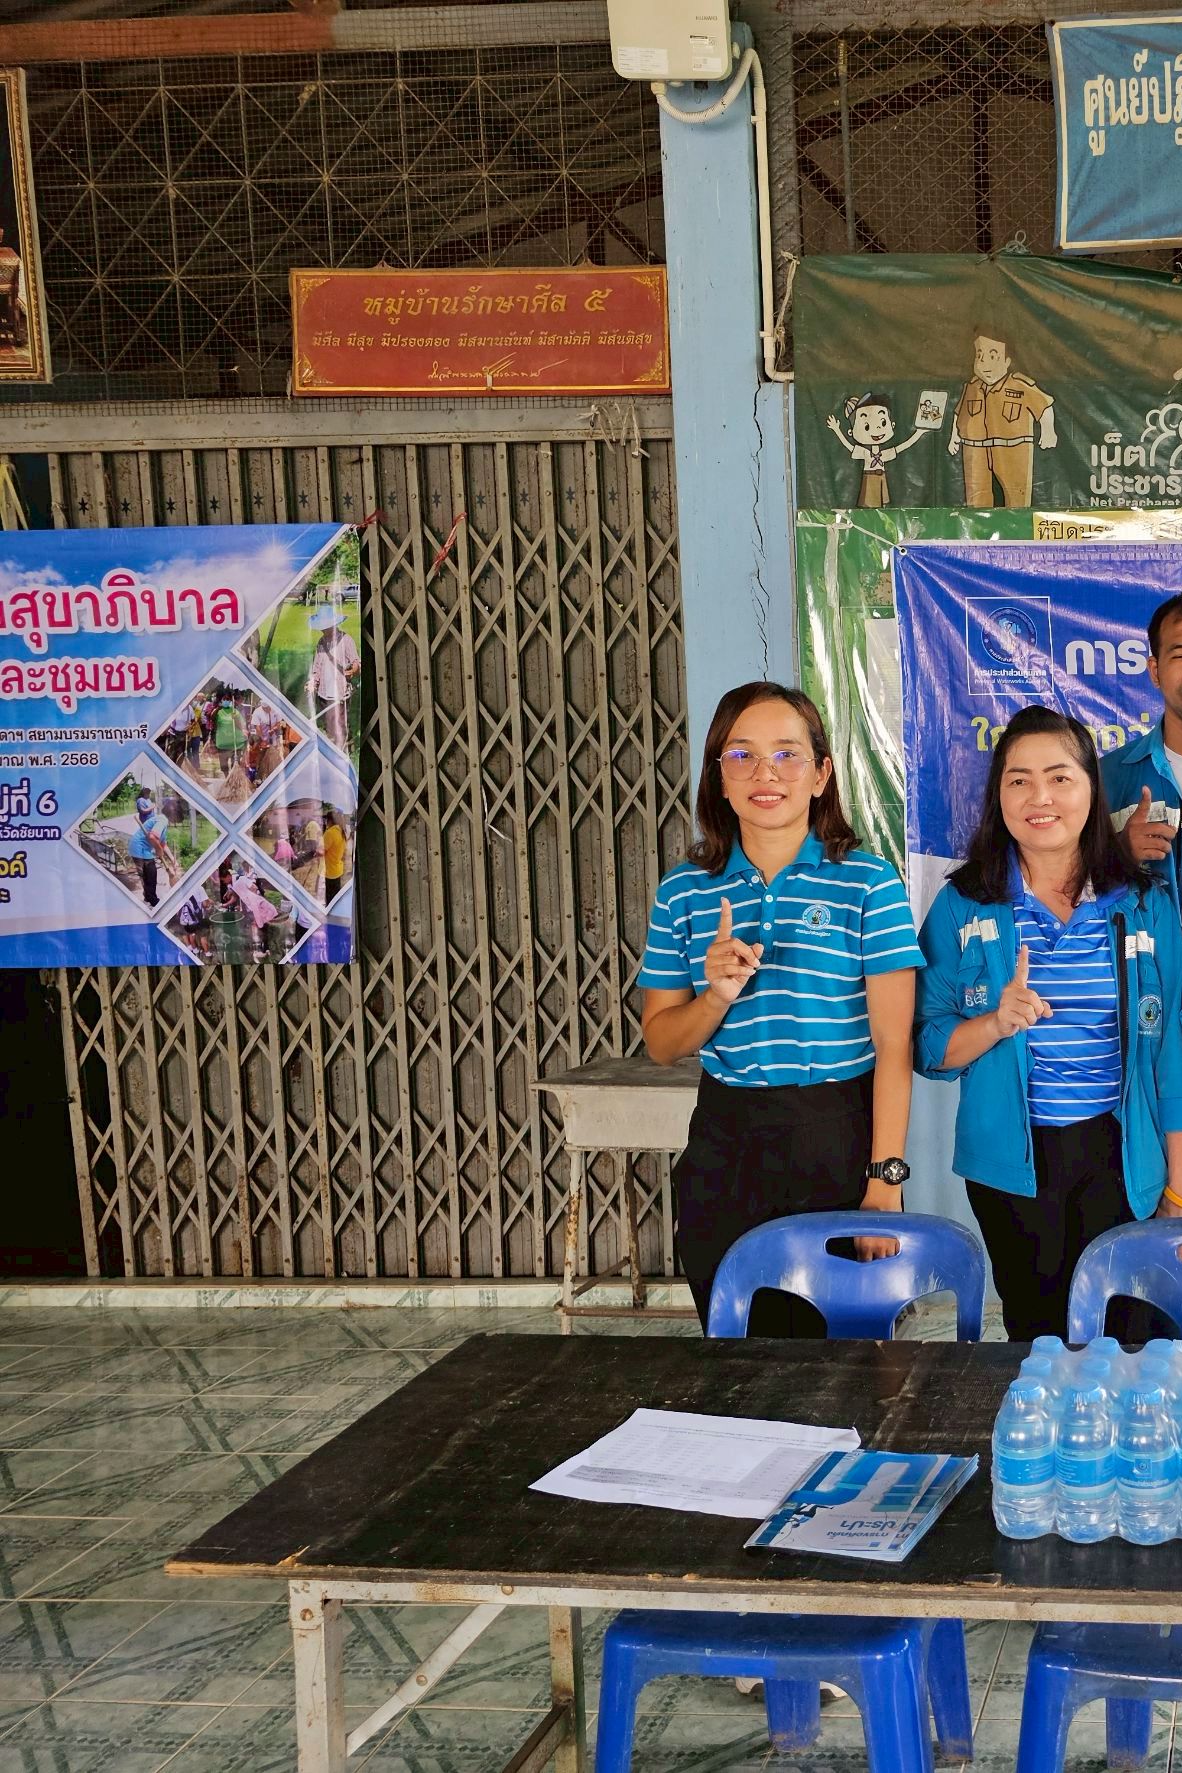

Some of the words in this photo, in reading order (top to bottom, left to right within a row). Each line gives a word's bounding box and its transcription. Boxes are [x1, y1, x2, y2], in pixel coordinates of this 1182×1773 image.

[363, 283, 568, 325] หมู่บ้านรักษาศีล
[584, 288, 613, 312] ๕
[381, 332, 450, 347] มีปรองดอง
[1091, 432, 1146, 467] เน็ต
[1090, 497, 1112, 507] Net
[1117, 497, 1181, 507] Pracharat
[28, 725, 148, 744] สยามบรมราชกุมารี
[29, 755, 57, 766] พ.ศ.
[61, 753, 99, 766] 2568
[38, 790, 57, 815] 6
